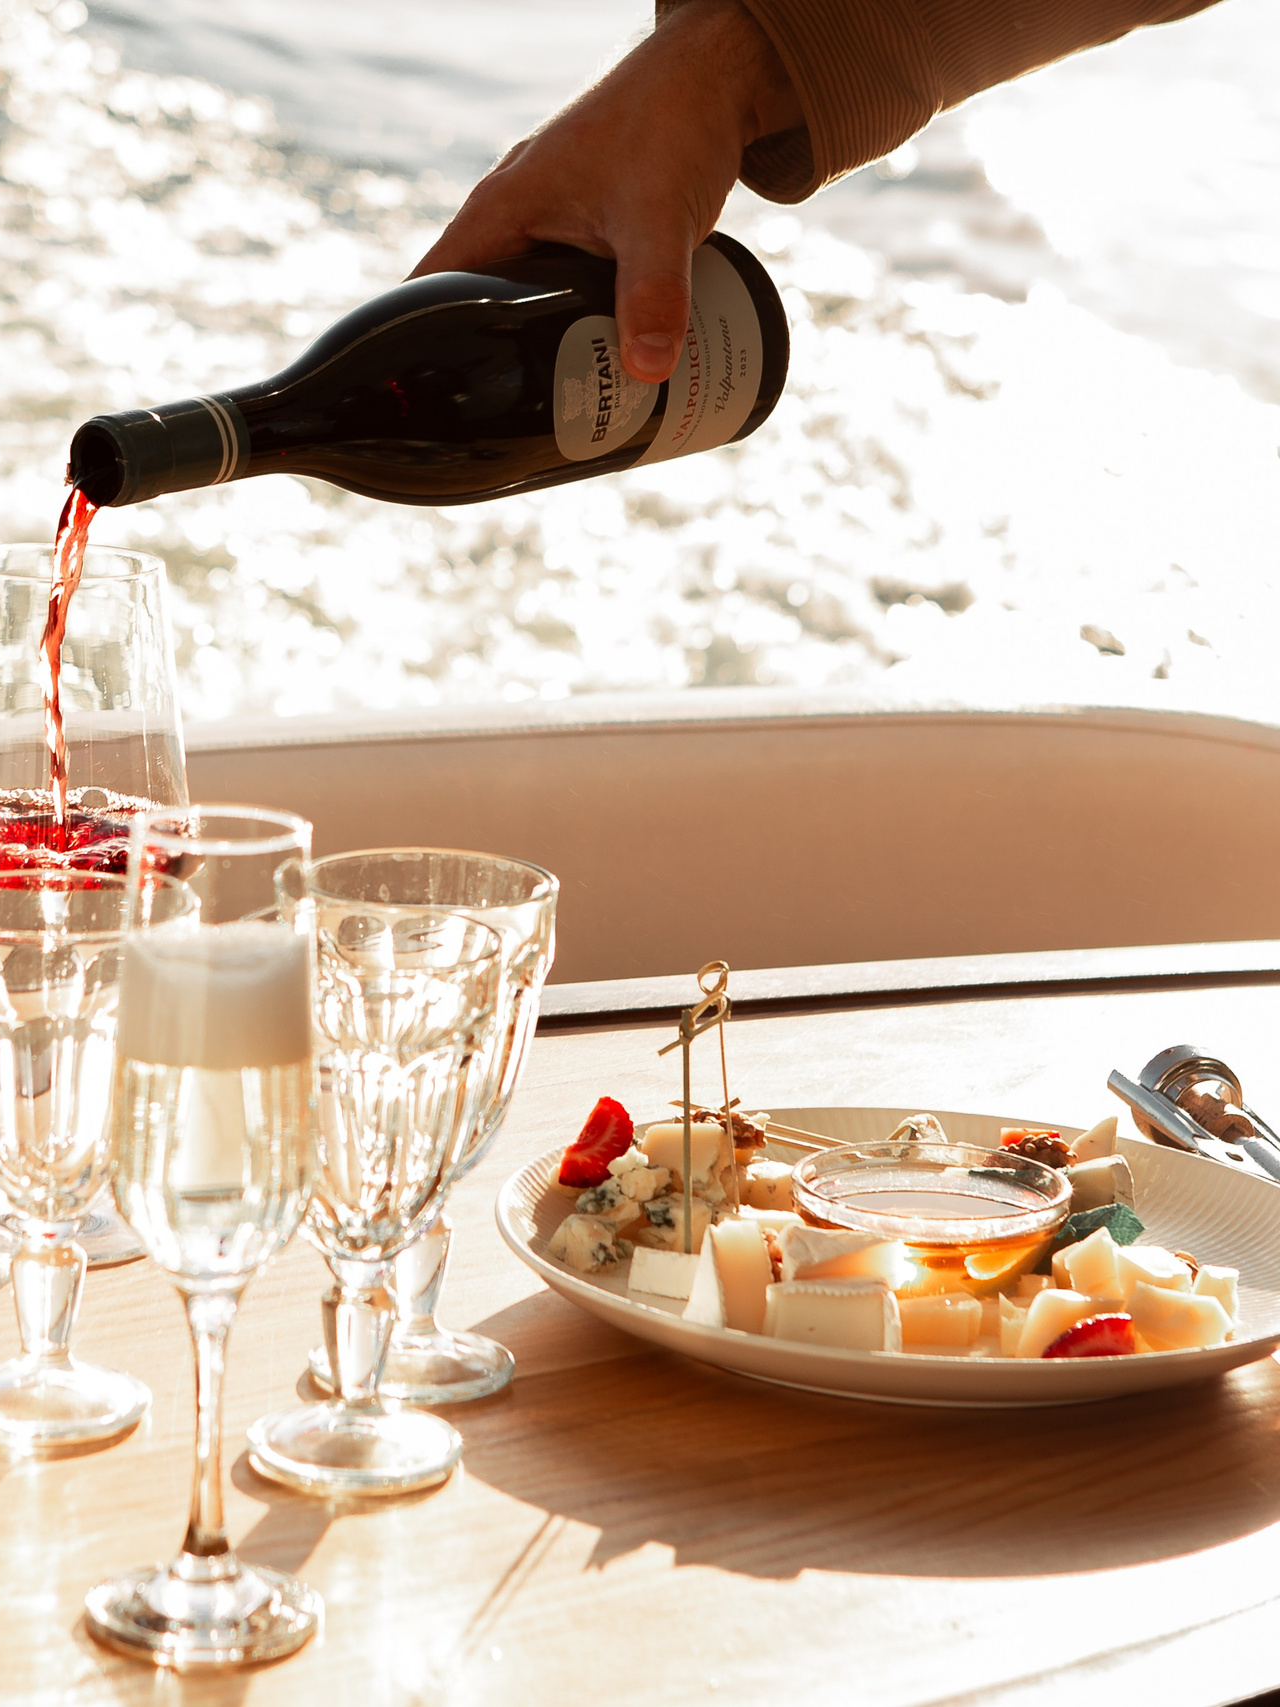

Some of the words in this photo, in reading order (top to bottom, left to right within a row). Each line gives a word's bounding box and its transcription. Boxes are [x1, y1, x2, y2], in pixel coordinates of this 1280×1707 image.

[591, 337, 613, 443] BERTANI
[671, 317, 701, 442] VALPOLICEL
[703, 338, 711, 377] ORIGINE
[704, 379, 711, 391] DI
[714, 315, 736, 414] Valpantena
